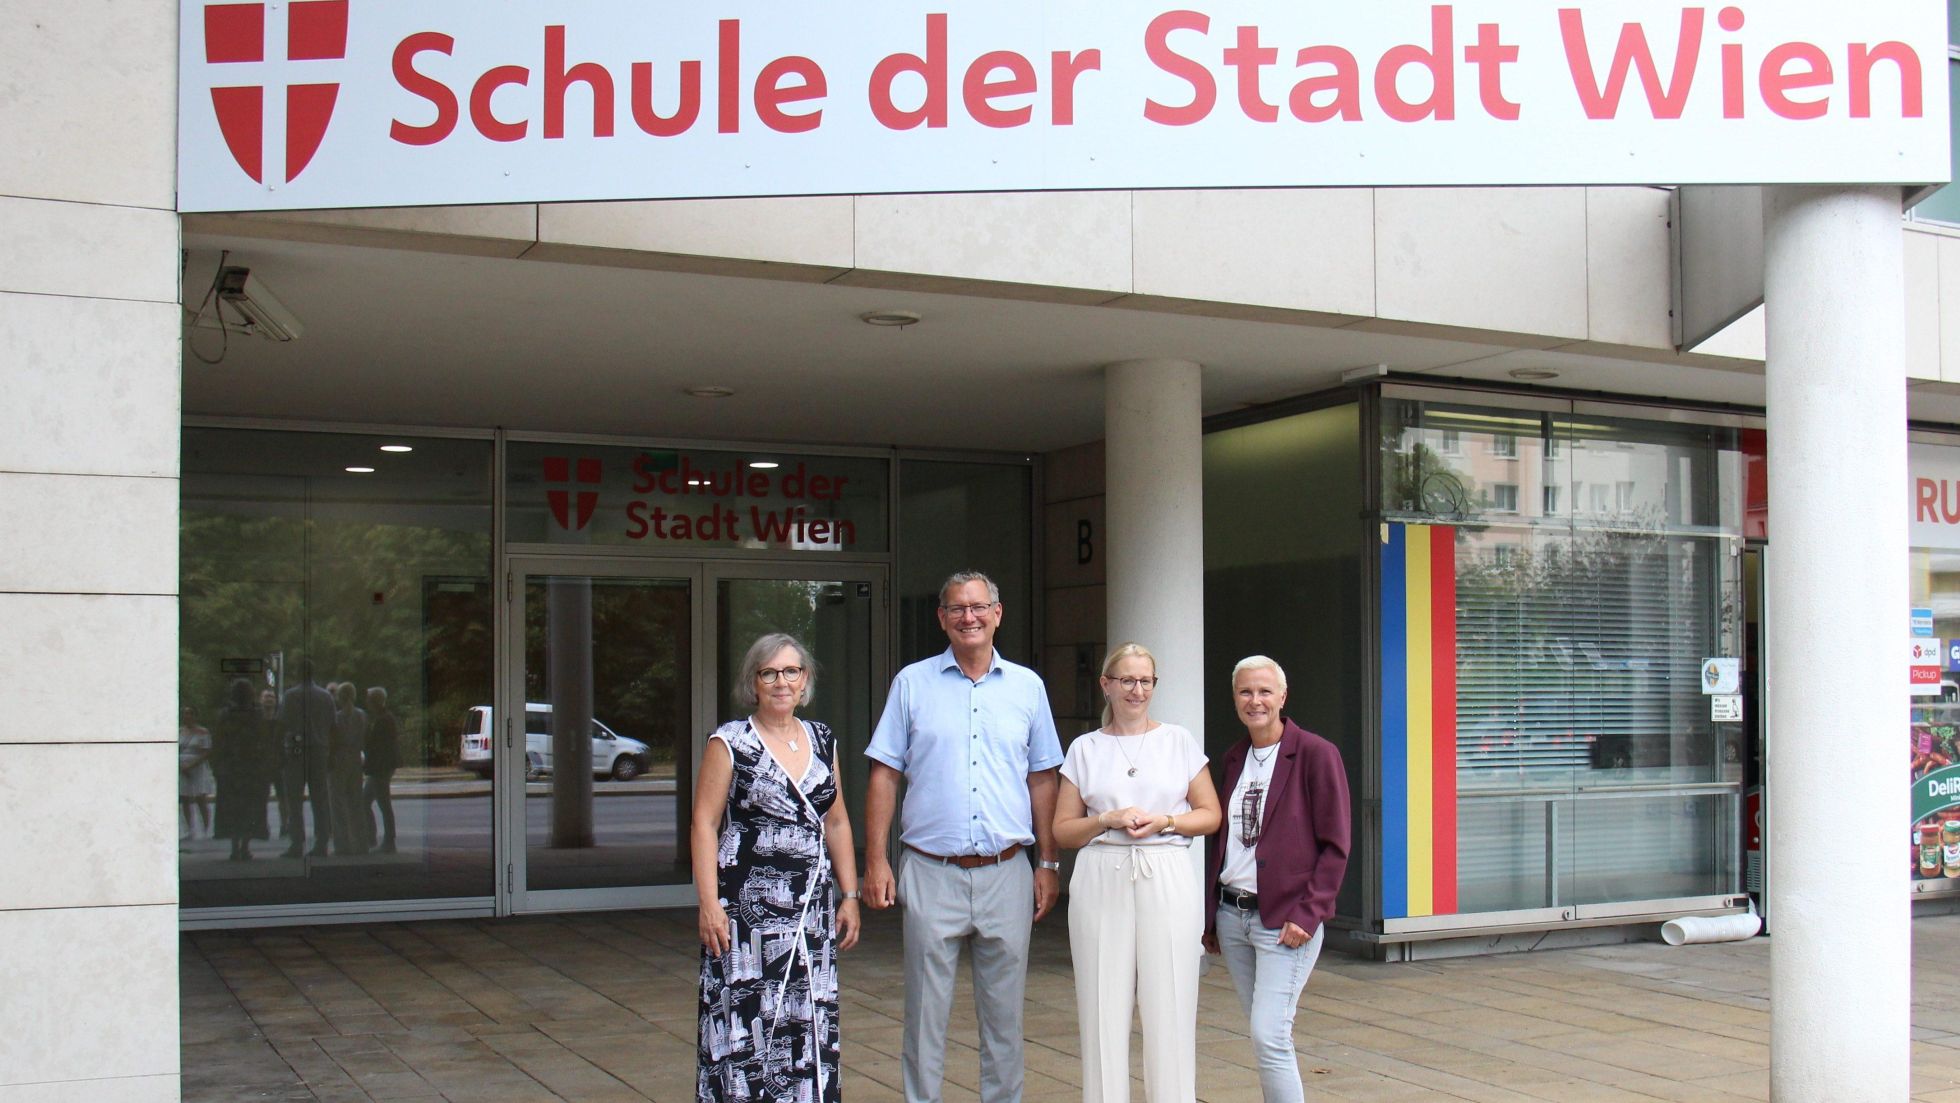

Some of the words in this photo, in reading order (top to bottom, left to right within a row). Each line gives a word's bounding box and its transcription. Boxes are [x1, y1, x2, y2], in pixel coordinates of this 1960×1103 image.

[391, 19, 827, 146] Schule
[869, 13, 1100, 130] der
[1144, 4, 1521, 127] Stadt
[1558, 6, 1923, 121] Wien
[632, 453, 770, 497] Schule
[781, 463, 848, 500] der
[626, 500, 740, 541] Stadt
[750, 505, 856, 544] Wien
[1917, 478, 1960, 524] RU
[1077, 519, 1093, 565] B
[1912, 669, 1937, 680] Pickup
[1924, 648, 1937, 658] dpd
